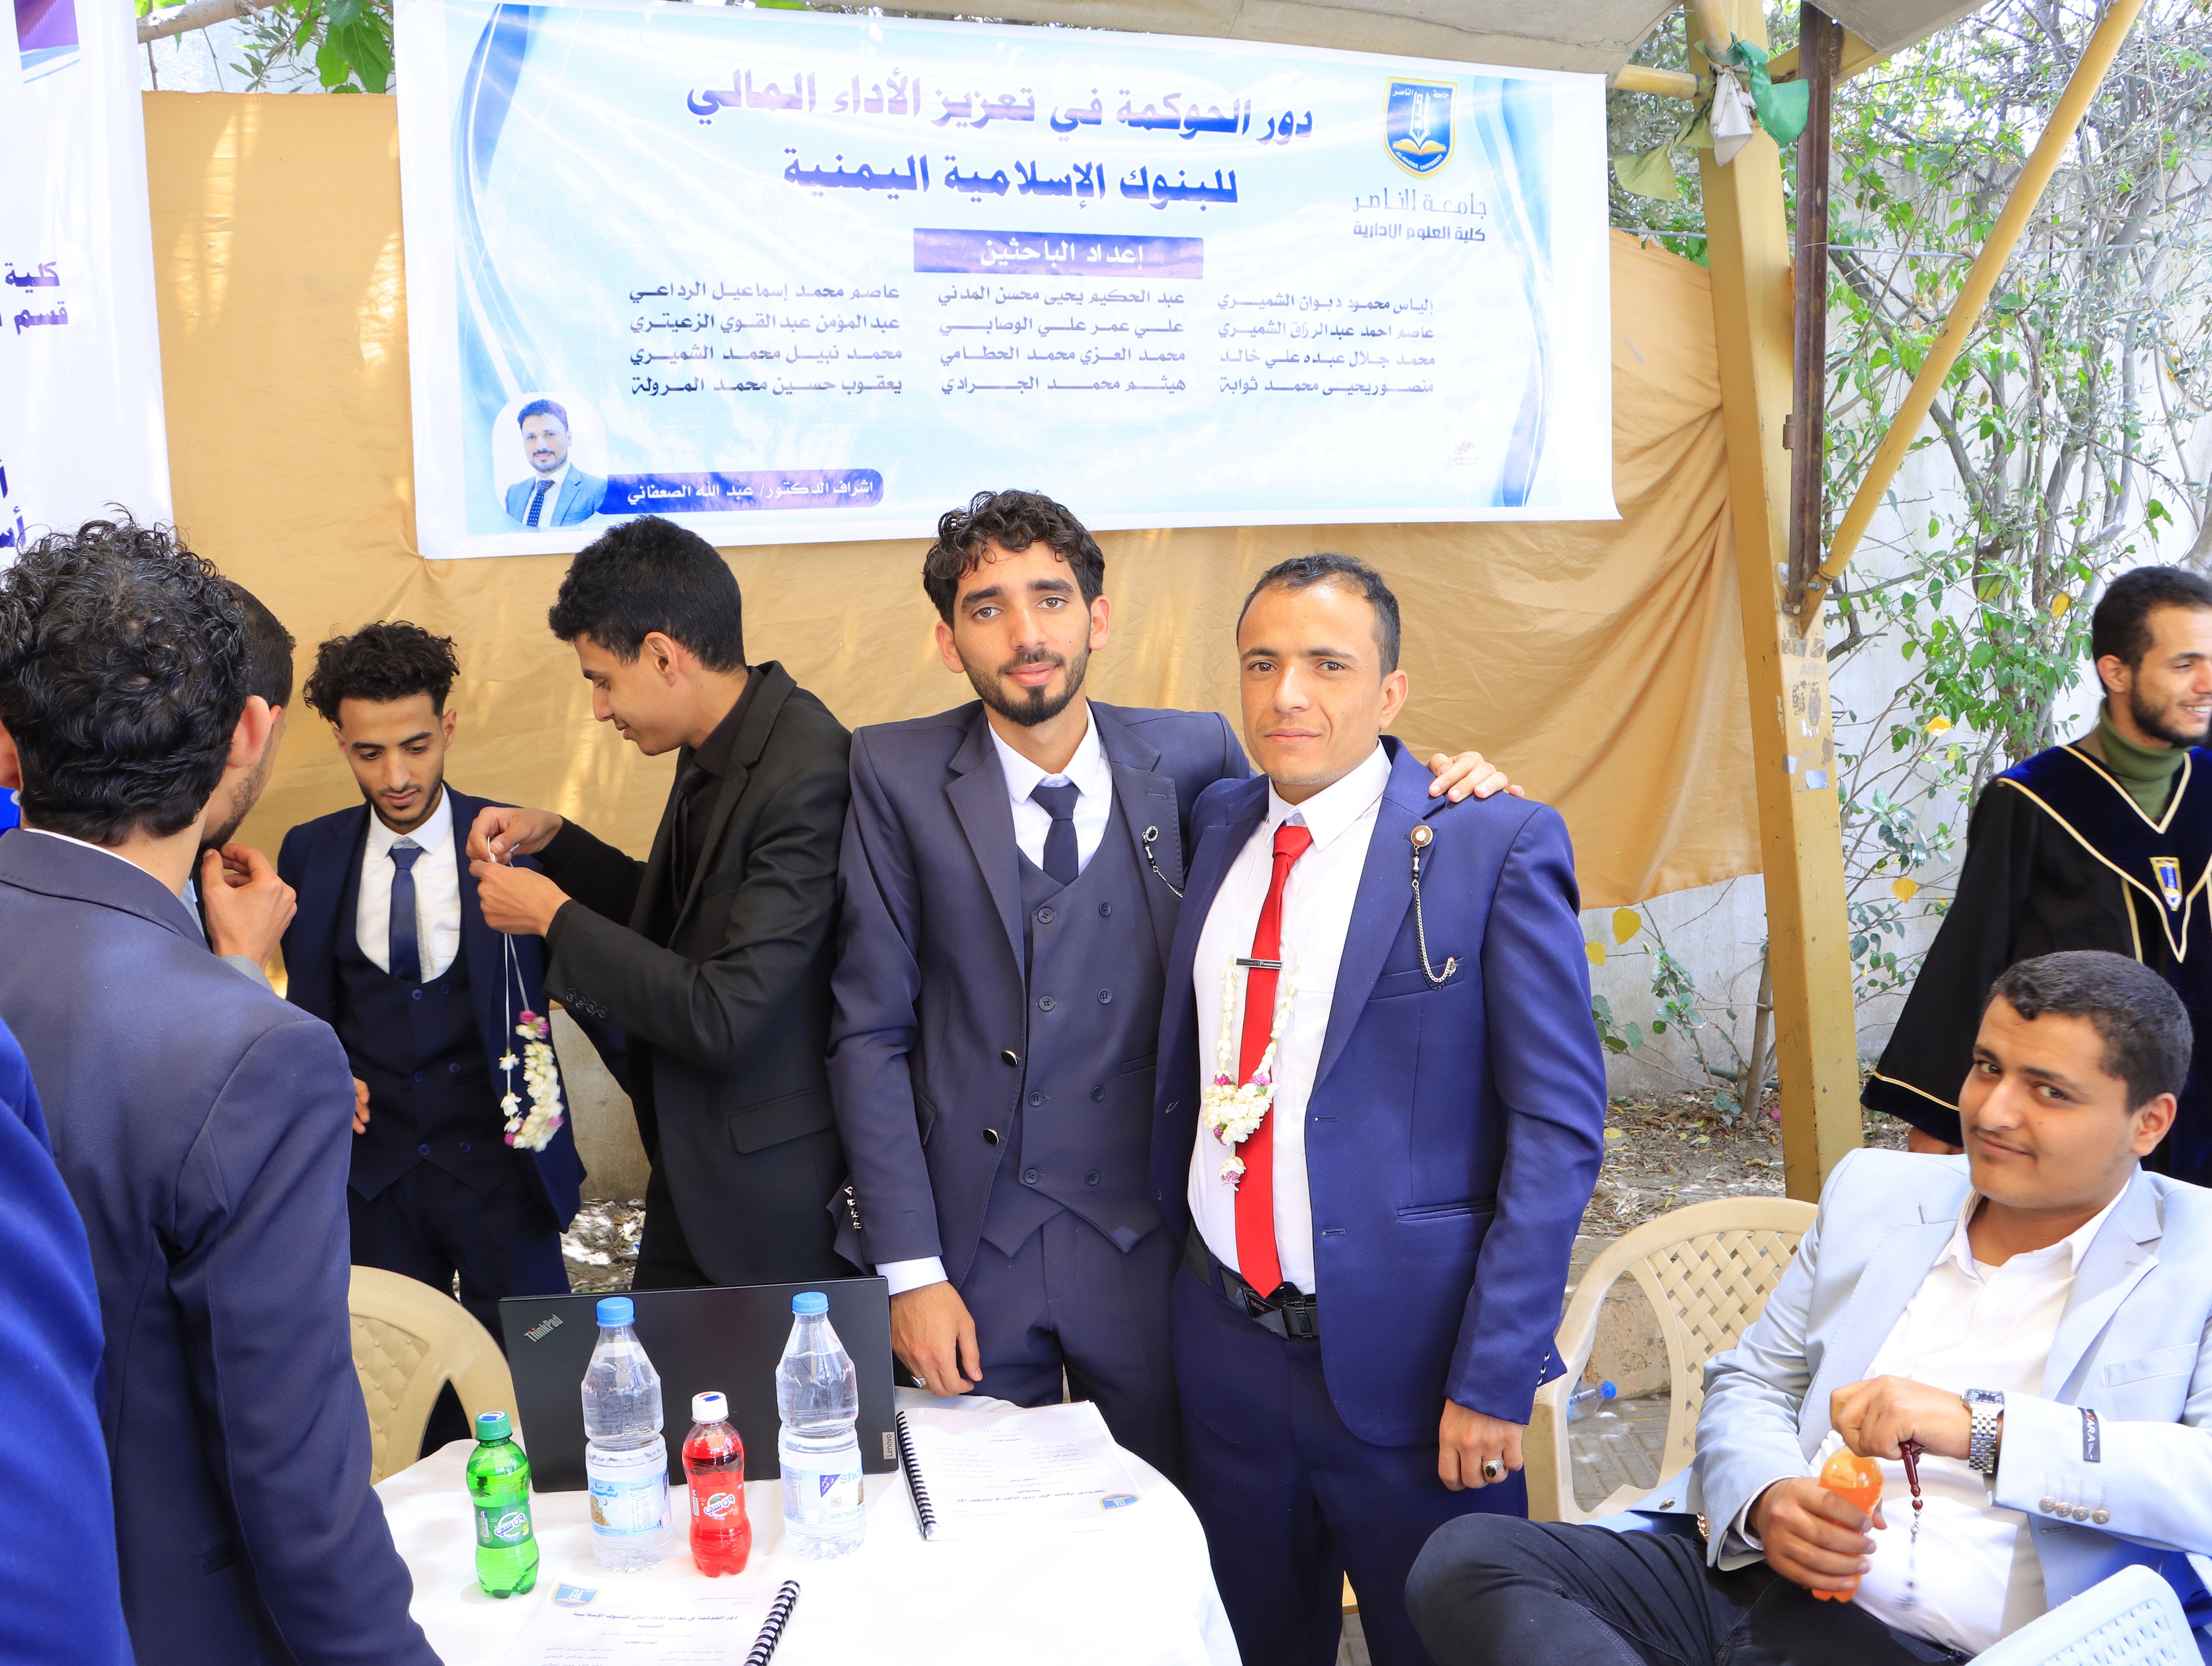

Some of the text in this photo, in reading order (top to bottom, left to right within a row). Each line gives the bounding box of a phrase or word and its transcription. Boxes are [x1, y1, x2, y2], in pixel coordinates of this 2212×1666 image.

[686, 67, 1313, 146] دور الحوكمة في تعزيز الأداء المالي
[784, 148, 1237, 211] للبنوك الإسلامية اليمنية
[1353, 187, 1487, 219] جامعة الناصر
[1407, 226, 1450, 240] العلوم
[1455, 227, 1485, 243] كلية
[980, 237, 1143, 270] إعداد الباحثين
[5, 262, 59, 293] كلية
[629, 281, 705, 303] الرداعي
[796, 285, 844, 297] محمد
[849, 284, 900, 300] عاصم
[938, 285, 1184, 308] عبد الحكيم يحيى محسن المدني
[1218, 293, 1294, 310] الشميري
[1349, 299, 1390, 312] محمود
[14, 301, 68, 335] قسم
[631, 313, 714, 333] الزعيتري
[940, 316, 1184, 338] علي عمر علي الوصابي
[1218, 320, 1286, 338] الشميري
[1396, 326, 1434, 339] عاصم
[630, 344, 902, 366] محمد نبيل محمد الشميري
[940, 345, 1185, 366] محمد العزي محمد الحطامي
[1221, 348, 1435, 369] محمد جلال عبده علي خالد
[713, 377, 767, 392] محمد
[772, 377, 836, 395] حسين
[842, 375, 902, 395] يعقوب
[942, 375, 1185, 395] هيثم محمد الجرادي
[1265, 380, 1318, 392] محمد
[628, 485, 691, 505] الصعفاني
[696, 481, 720, 501] الله
[727, 486, 753, 500] عبد
[524, 1314, 563, 1342] ThinkPad
